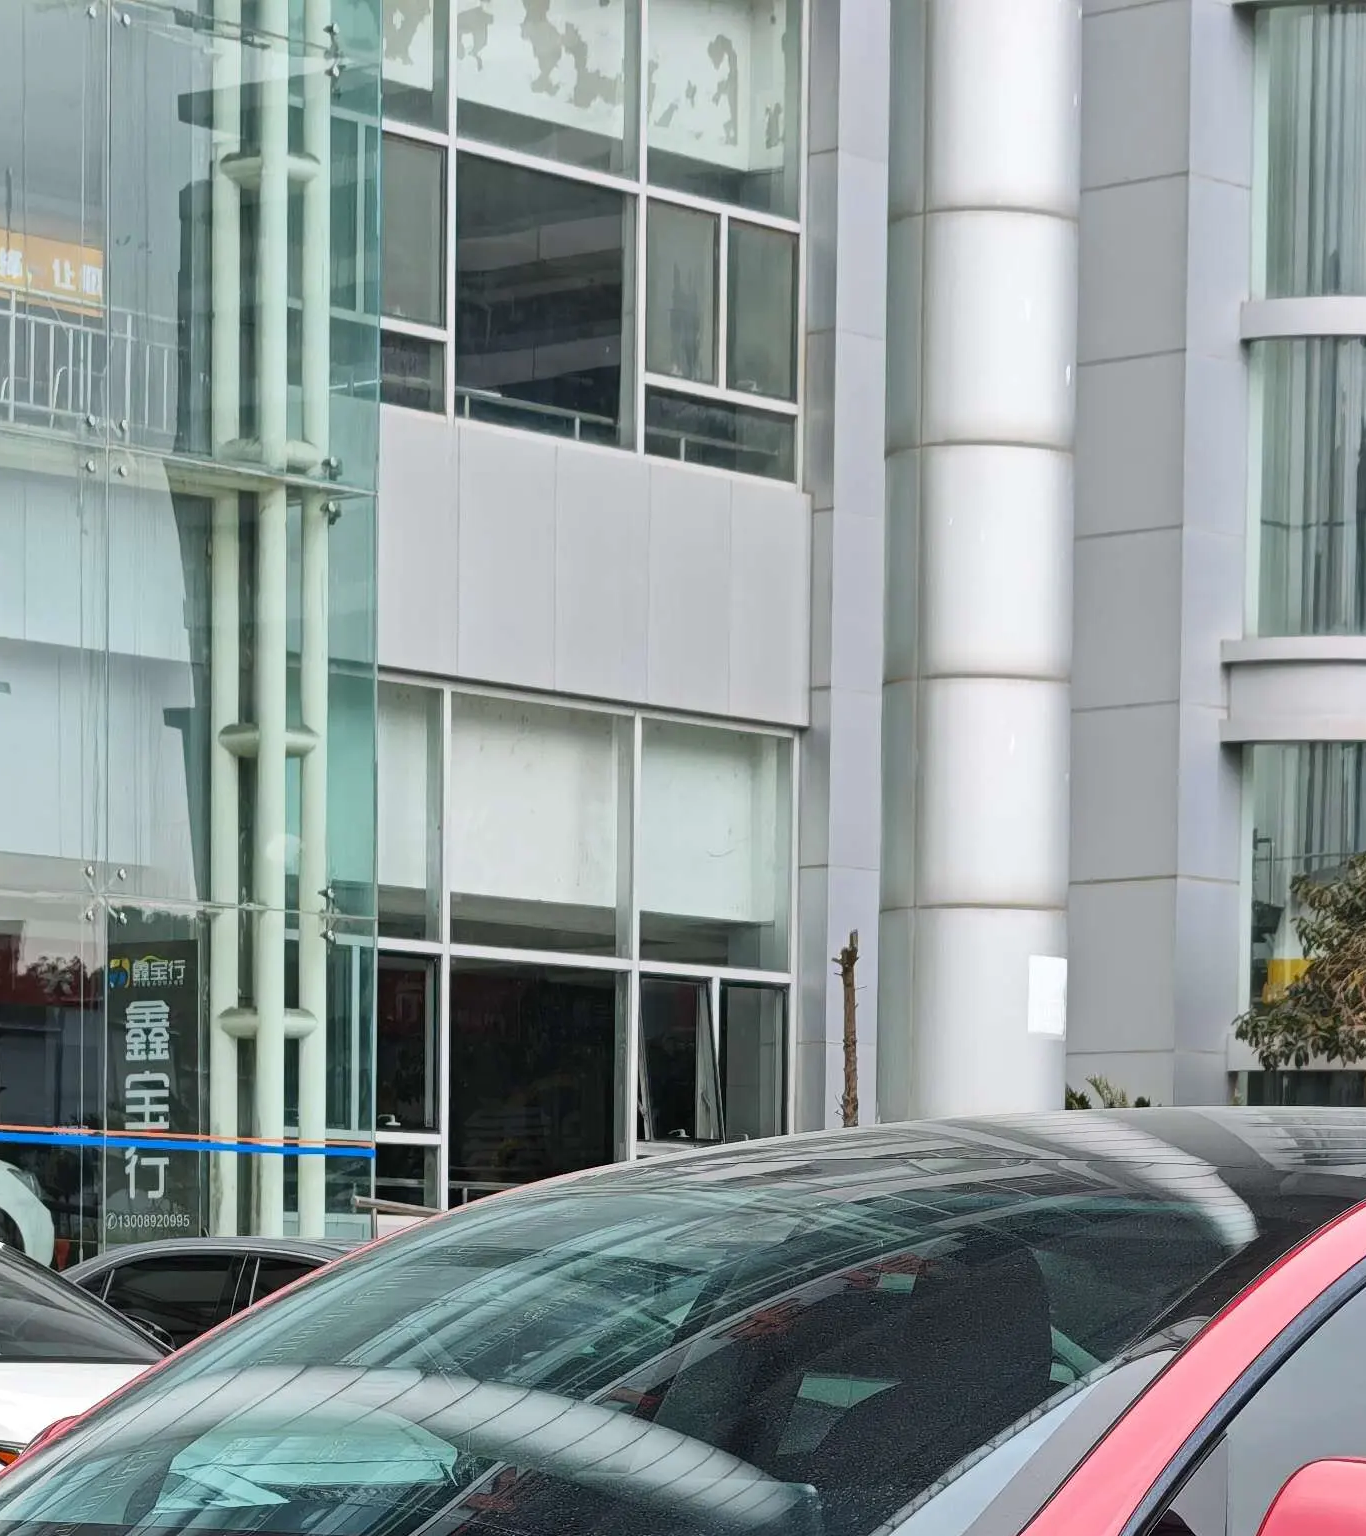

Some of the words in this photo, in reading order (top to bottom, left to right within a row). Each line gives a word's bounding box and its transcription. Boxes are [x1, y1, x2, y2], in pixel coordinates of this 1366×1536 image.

[133, 959, 186, 981] 鑫宝行
[125, 1000, 170, 1200] 鑫宝行
[118, 1214, 190, 1228] 13008920995
